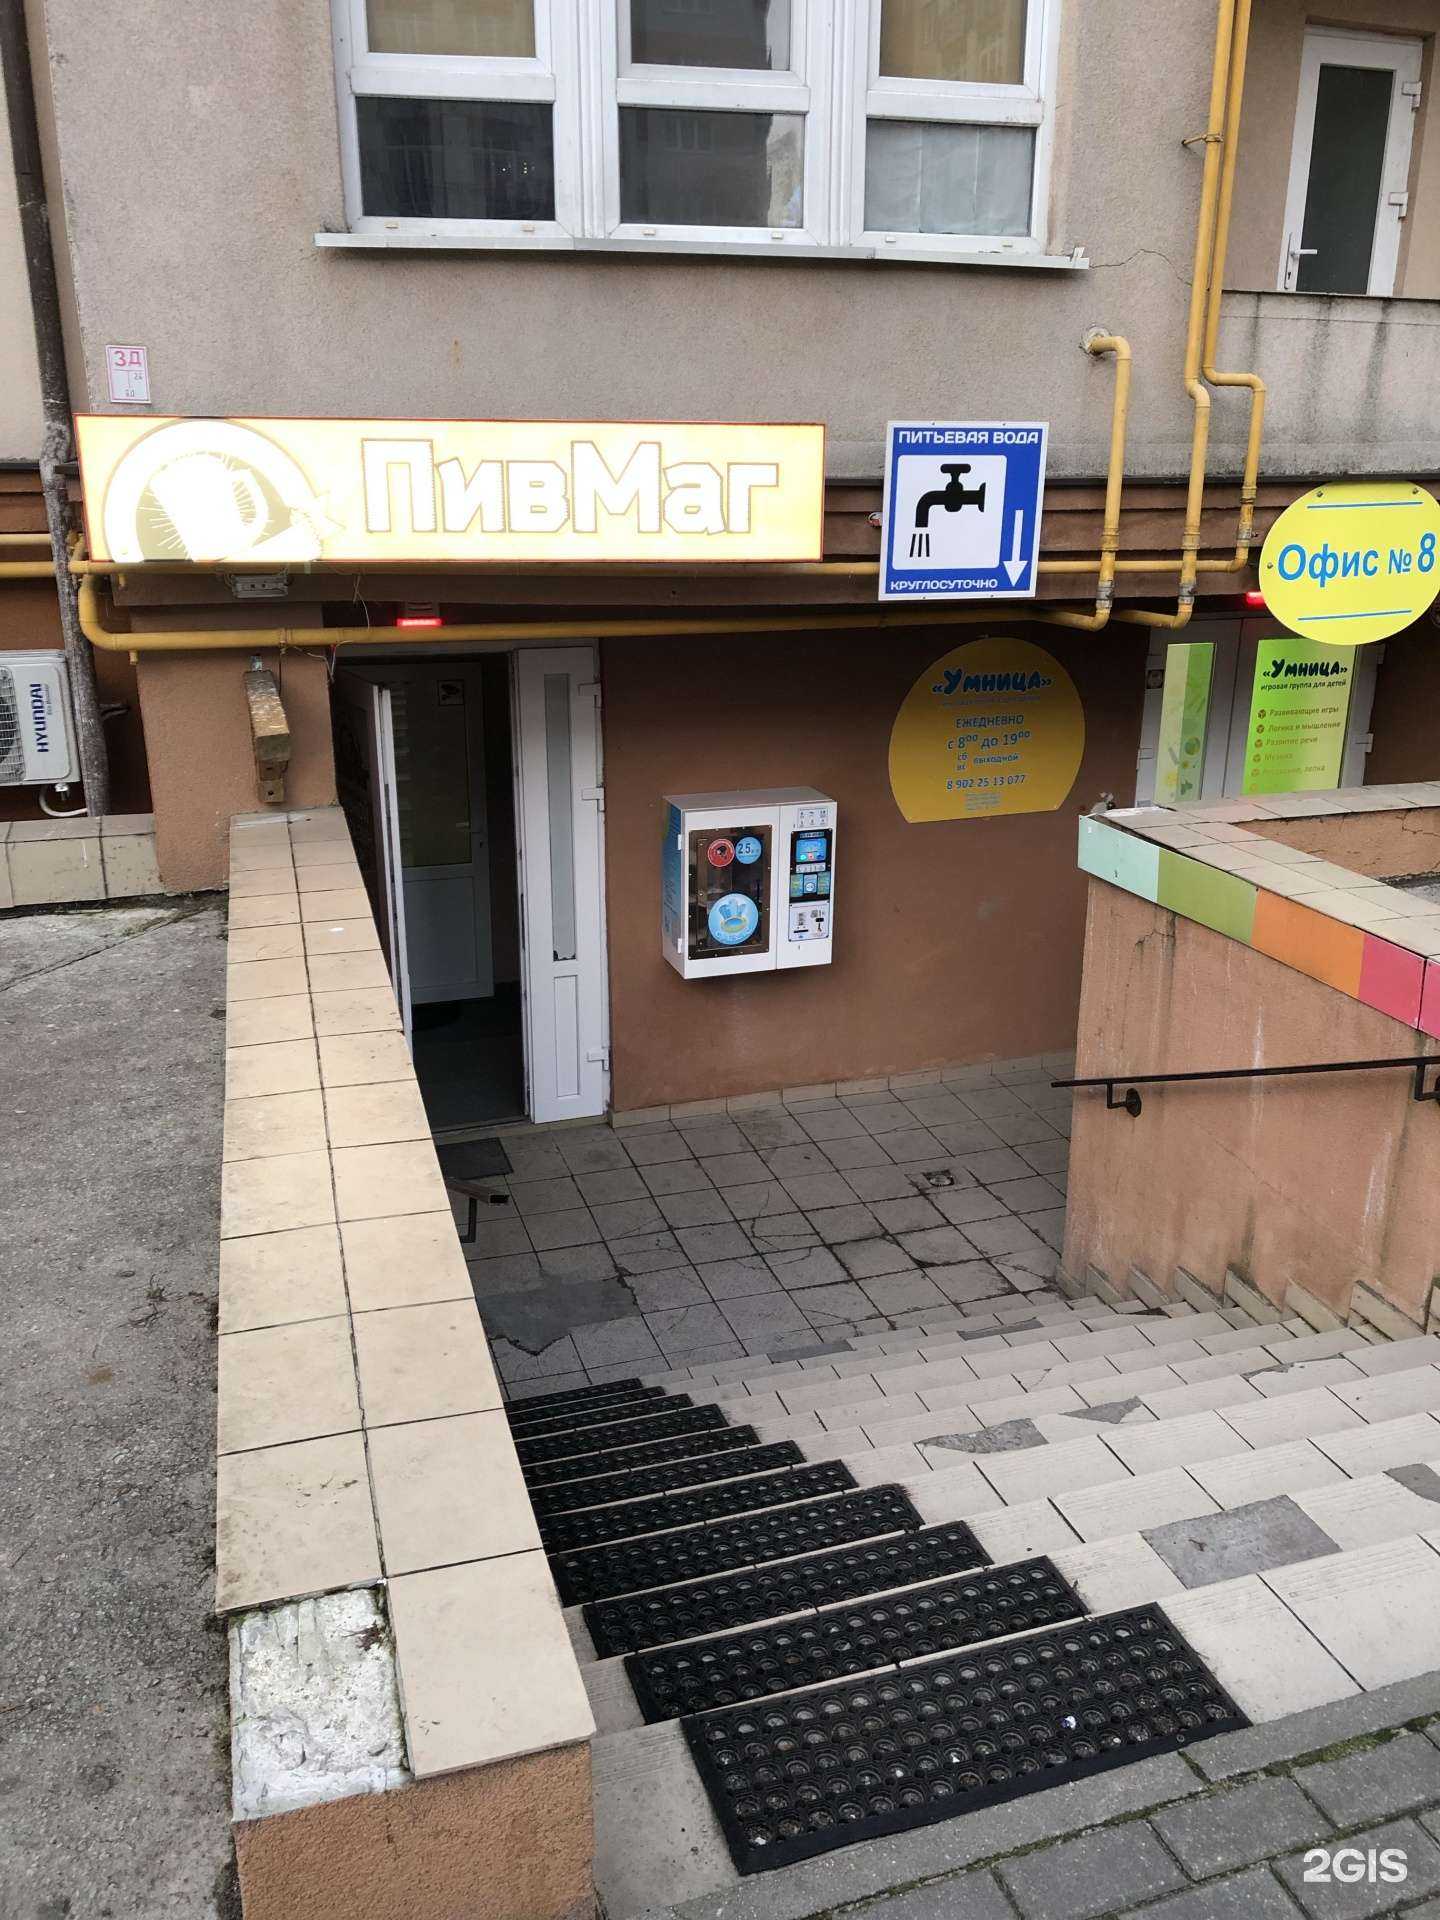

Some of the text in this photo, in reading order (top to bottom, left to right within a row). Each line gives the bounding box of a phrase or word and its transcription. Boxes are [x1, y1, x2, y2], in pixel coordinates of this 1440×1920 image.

[898, 431, 1039, 445] ПИТЬЕВАЯ ВОДА
[361, 438, 779, 535] ПивМаг
[1278, 532, 1436, 588] Офис № 8
[890, 578, 999, 591] КРУГЛОСУТОЧНО
[1260, 683, 1288, 692] игровая
[1289, 682, 1312, 691] группа
[1327, 680, 1347, 688] детей
[1321, 706, 1339, 714] игры
[30, 683, 49, 752] HYUNDAI
[956, 714, 1024, 729] ЕЖЕДНЕВНО
[980, 737, 998, 750] до
[946, 780, 953, 790] 8
[956, 779, 974, 789] 902
[977, 777, 990, 787] 25
